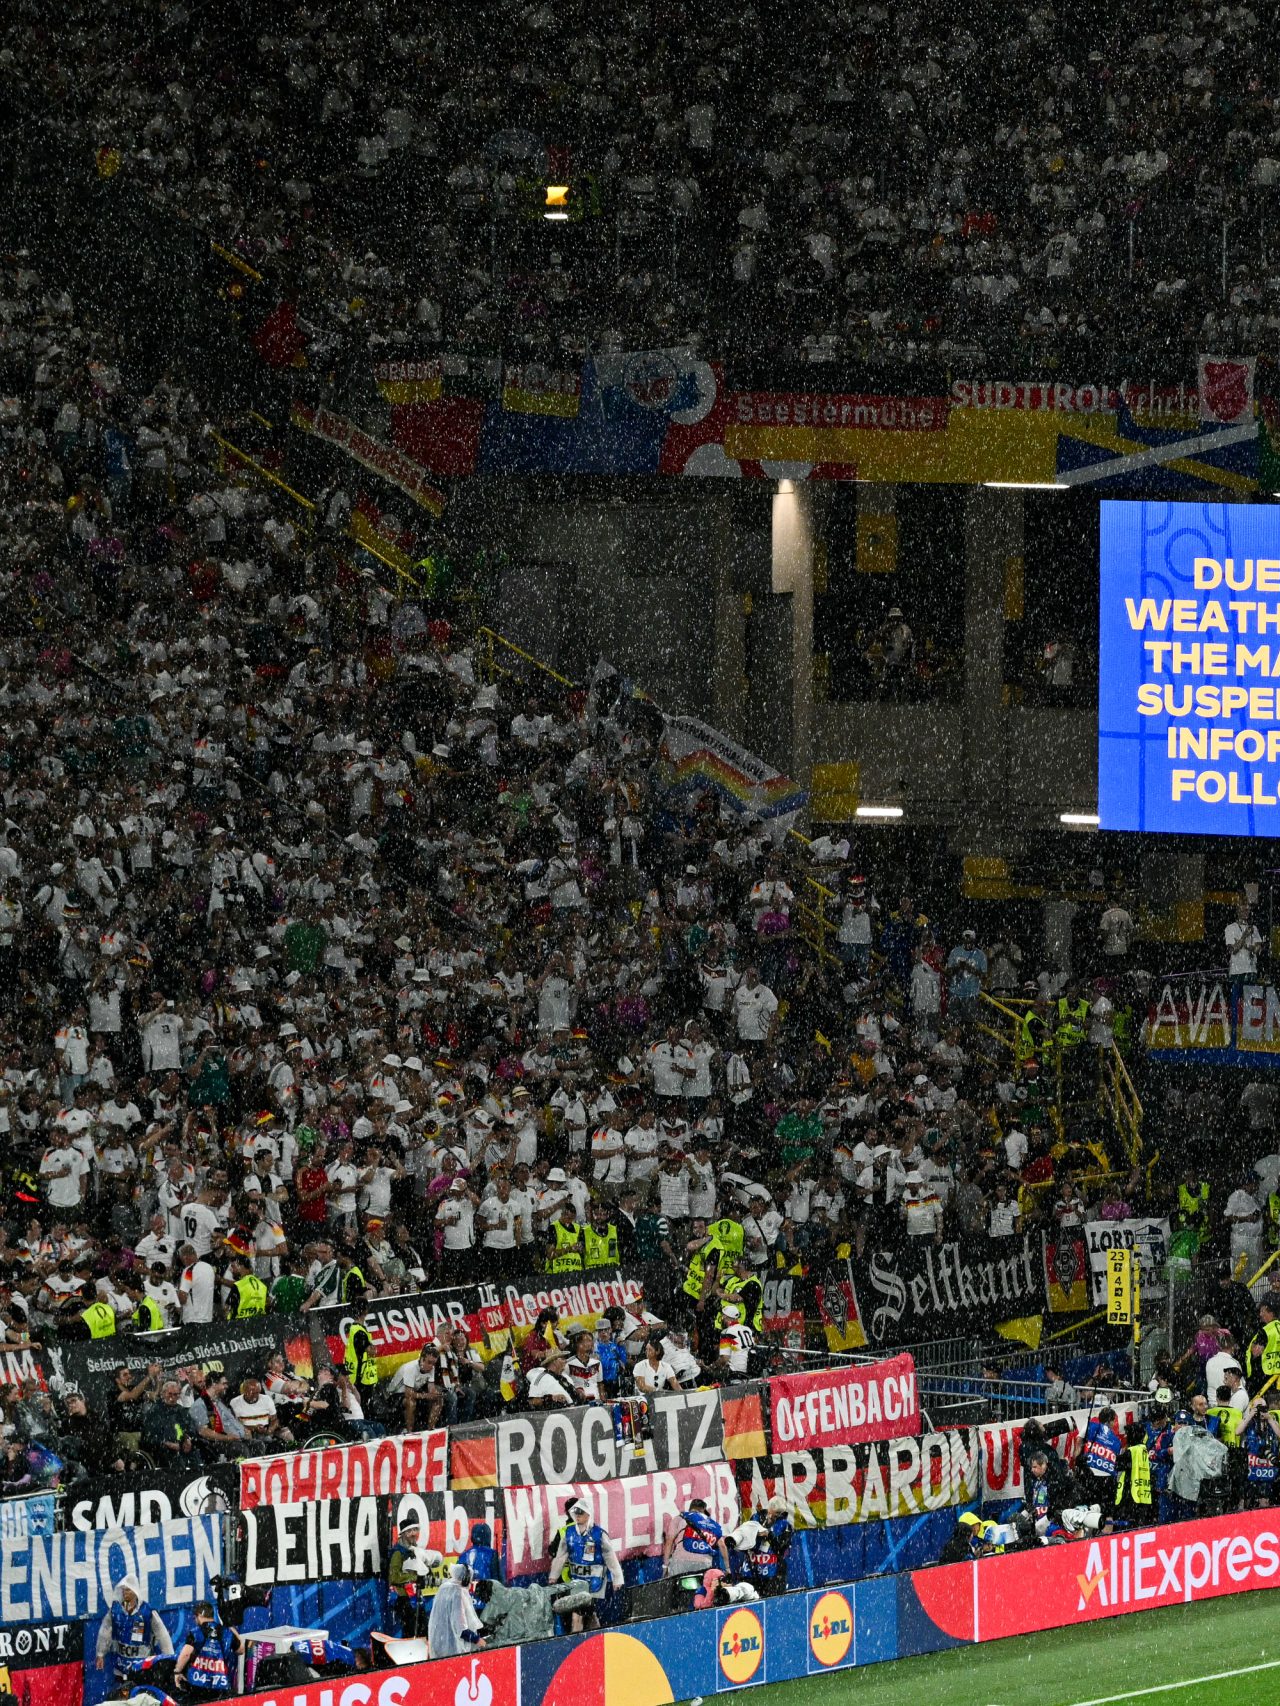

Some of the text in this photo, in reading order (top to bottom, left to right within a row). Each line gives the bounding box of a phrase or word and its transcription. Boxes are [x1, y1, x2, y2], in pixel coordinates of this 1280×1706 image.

[736, 394, 936, 429] Seestermühe
[1193, 557, 1280, 592] DUE
[1143, 640, 1228, 676] THE
[184, 1215, 198, 1239] 19
[1090, 1229, 1135, 1253] LORD
[1110, 1251, 1125, 1261] 23
[1114, 1276, 1122, 1286] 4
[763, 1279, 794, 1318] 99
[1114, 1301, 1122, 1311] 3
[230, 1334, 276, 1354] Duisburg
[737, 1329, 754, 1349] 10
[775, 1371, 917, 1443] OFFENBACH
[242, 1496, 382, 1586] LEIHA
